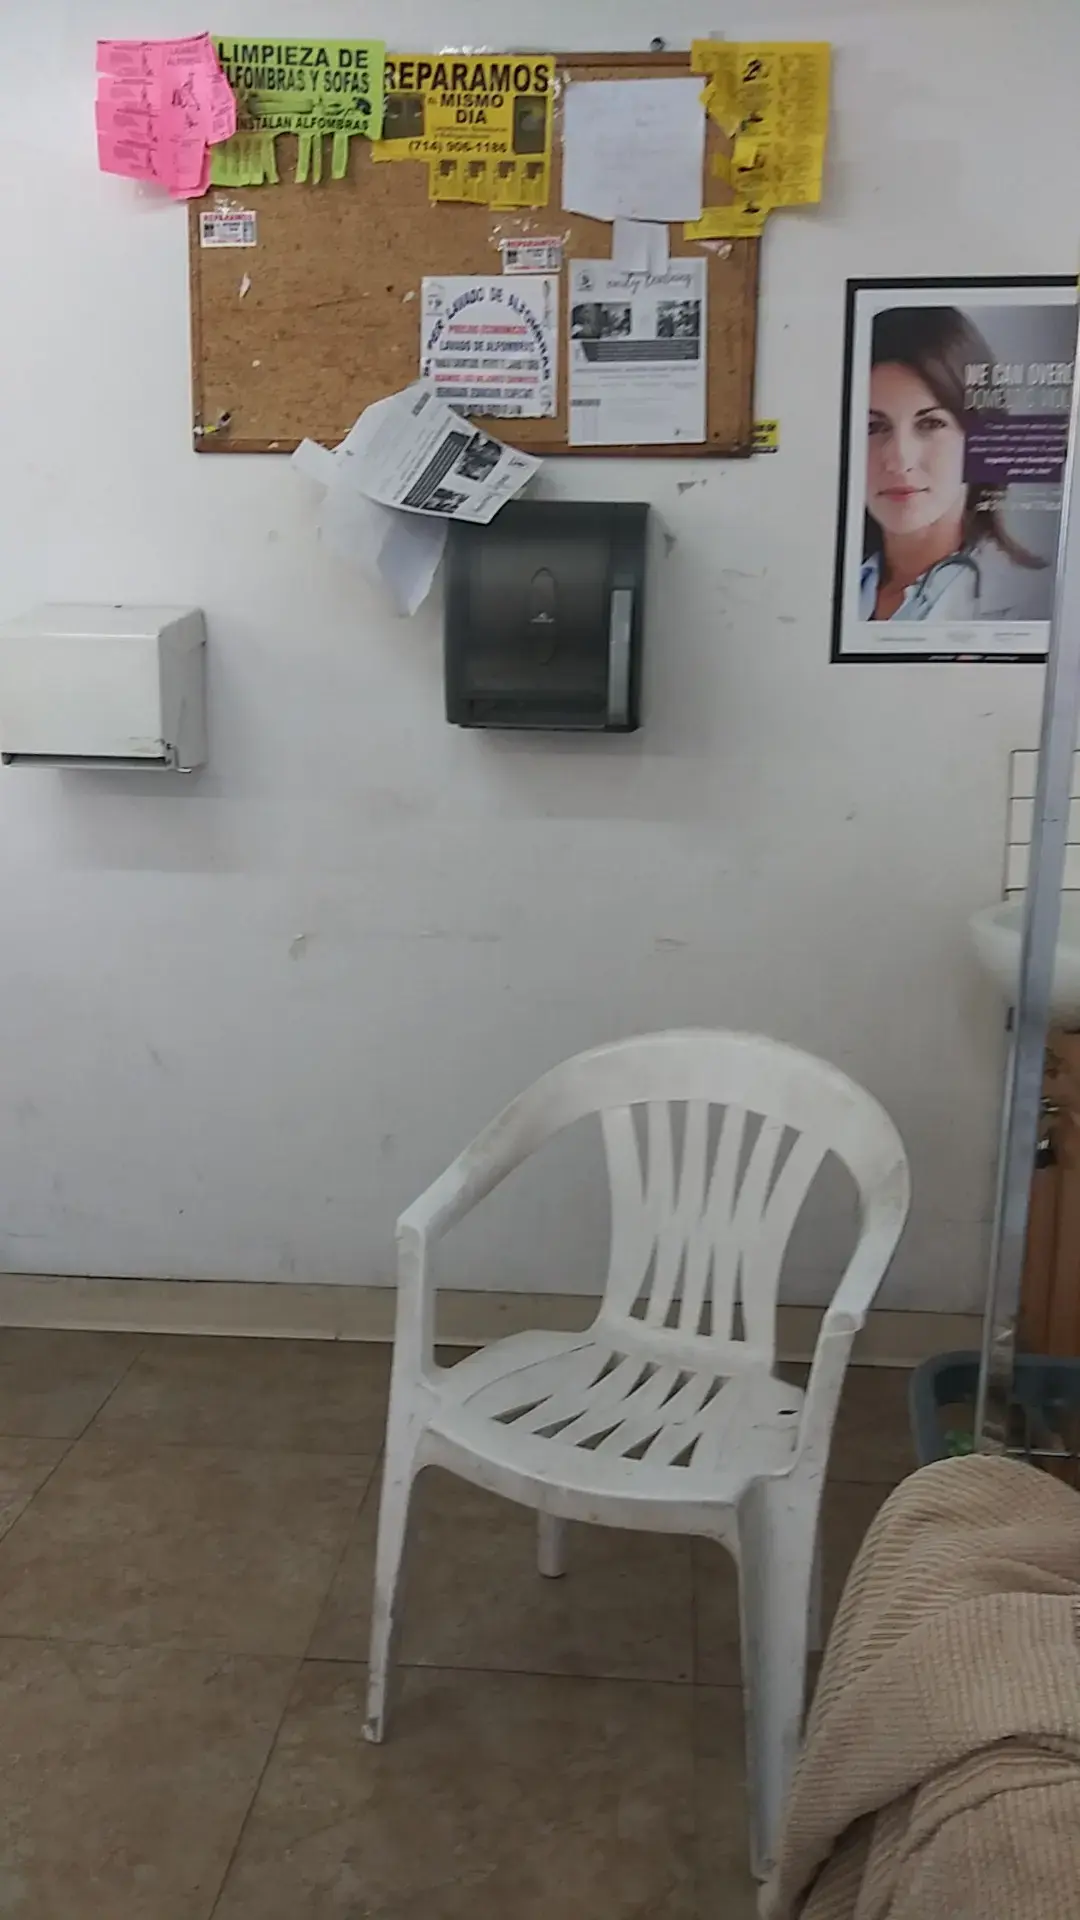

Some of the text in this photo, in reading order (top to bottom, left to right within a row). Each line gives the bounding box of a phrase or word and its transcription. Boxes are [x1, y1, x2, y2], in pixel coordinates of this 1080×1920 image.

[218, 42, 330, 67] LIMPIEZA
[339, 49, 368, 69] DE
[221, 64, 370, 94] LFOMBRAS Y SOFAS
[384, 62, 549, 93] REPARAMOS
[440, 93, 504, 108] MISMO
[296, 116, 369, 130] ALFOMBRAS
[455, 109, 488, 124] DIA
[964, 363, 990, 386] WE
